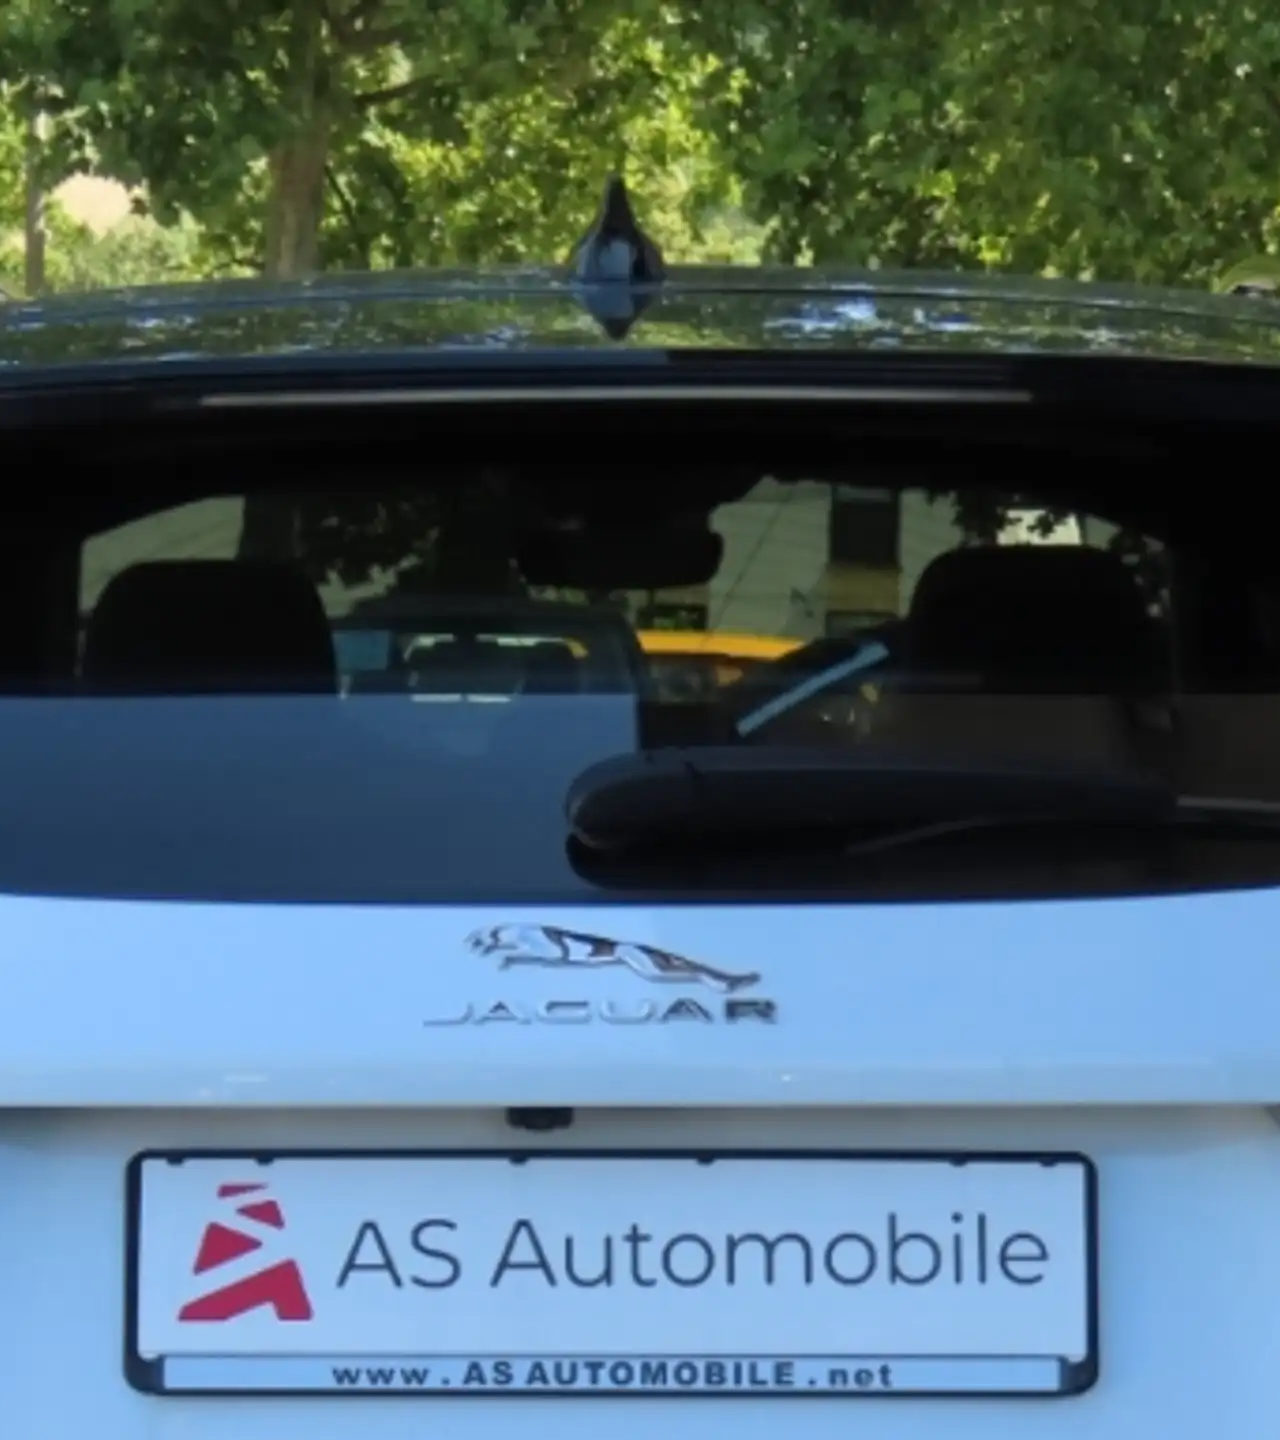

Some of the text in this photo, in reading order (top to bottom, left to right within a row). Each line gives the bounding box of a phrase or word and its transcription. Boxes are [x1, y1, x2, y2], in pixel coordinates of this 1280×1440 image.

[423, 998, 779, 1027] JAGUAR
[336, 1213, 1050, 1289] AS Automobile
